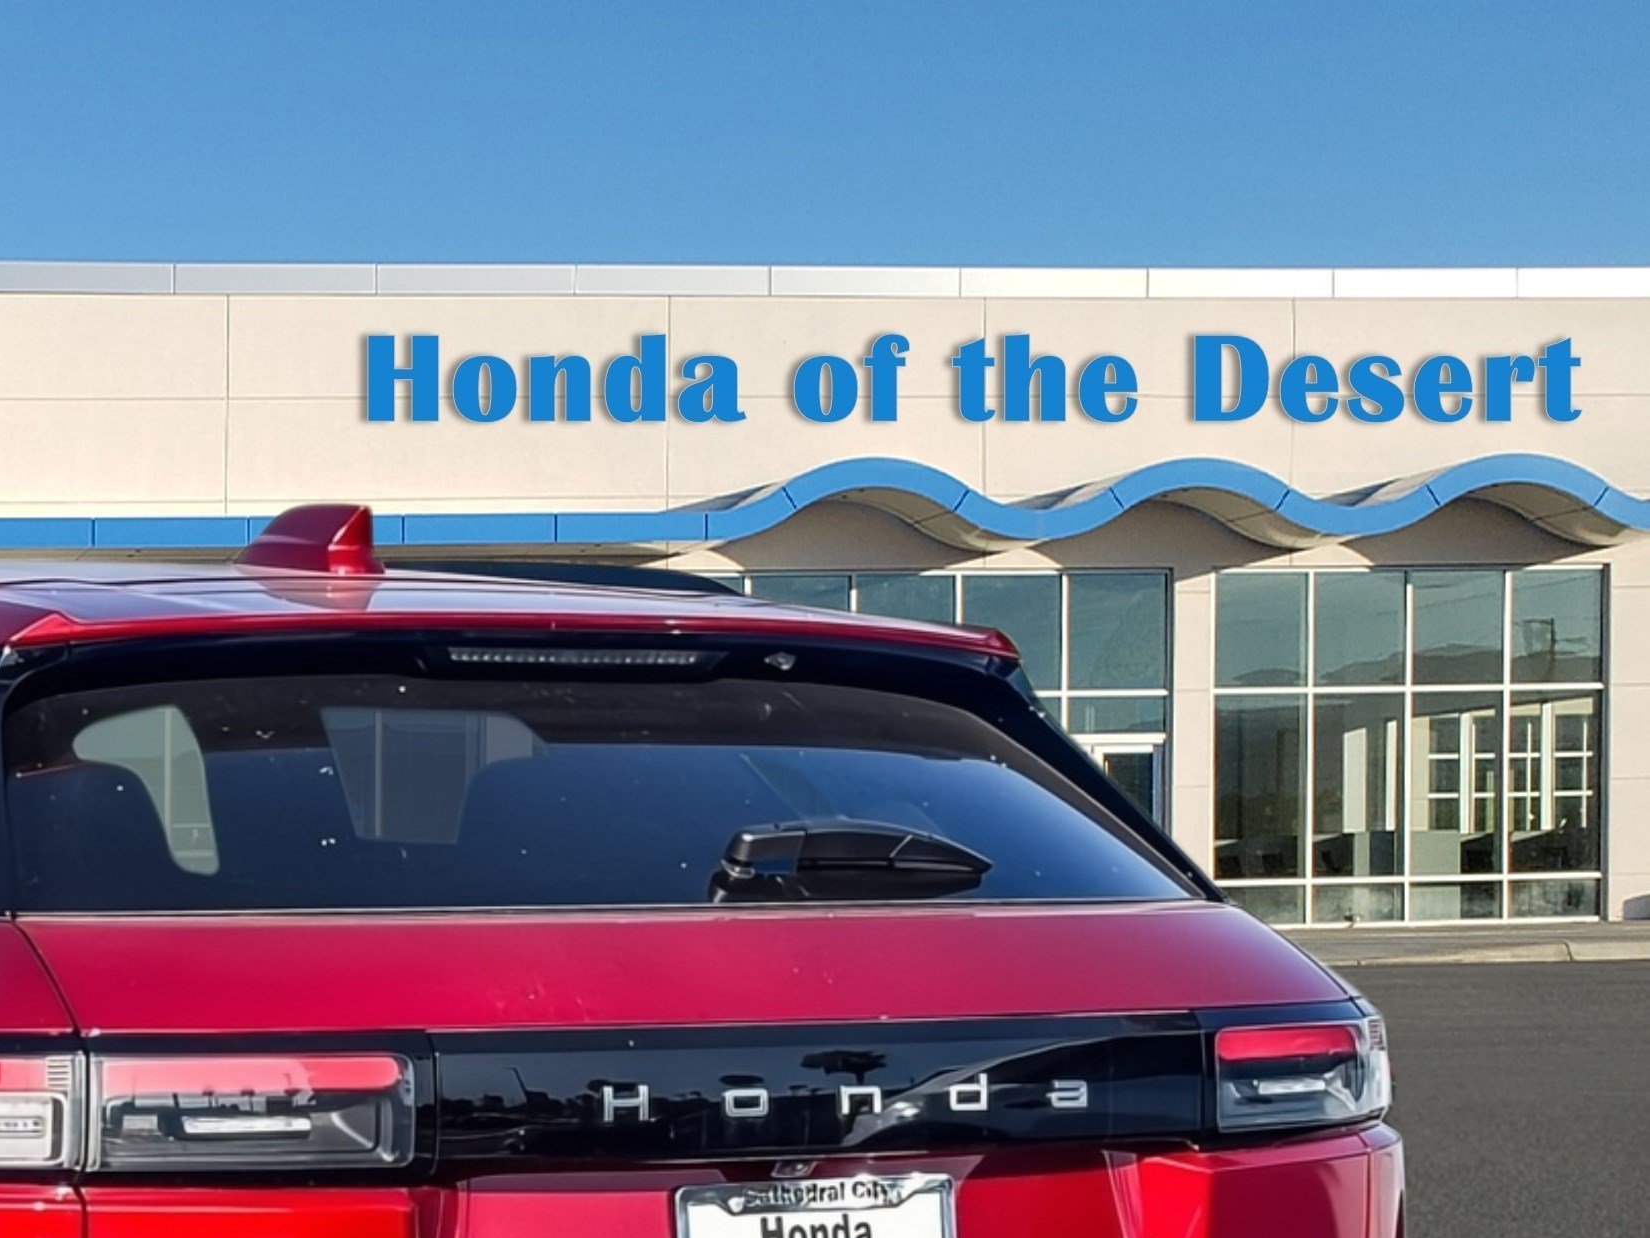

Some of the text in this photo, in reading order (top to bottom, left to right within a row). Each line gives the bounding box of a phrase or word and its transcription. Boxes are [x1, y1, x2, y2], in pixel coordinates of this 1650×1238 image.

[365, 332, 1583, 424] Honda of the Desert
[602, 1073, 1088, 1122] Honda
